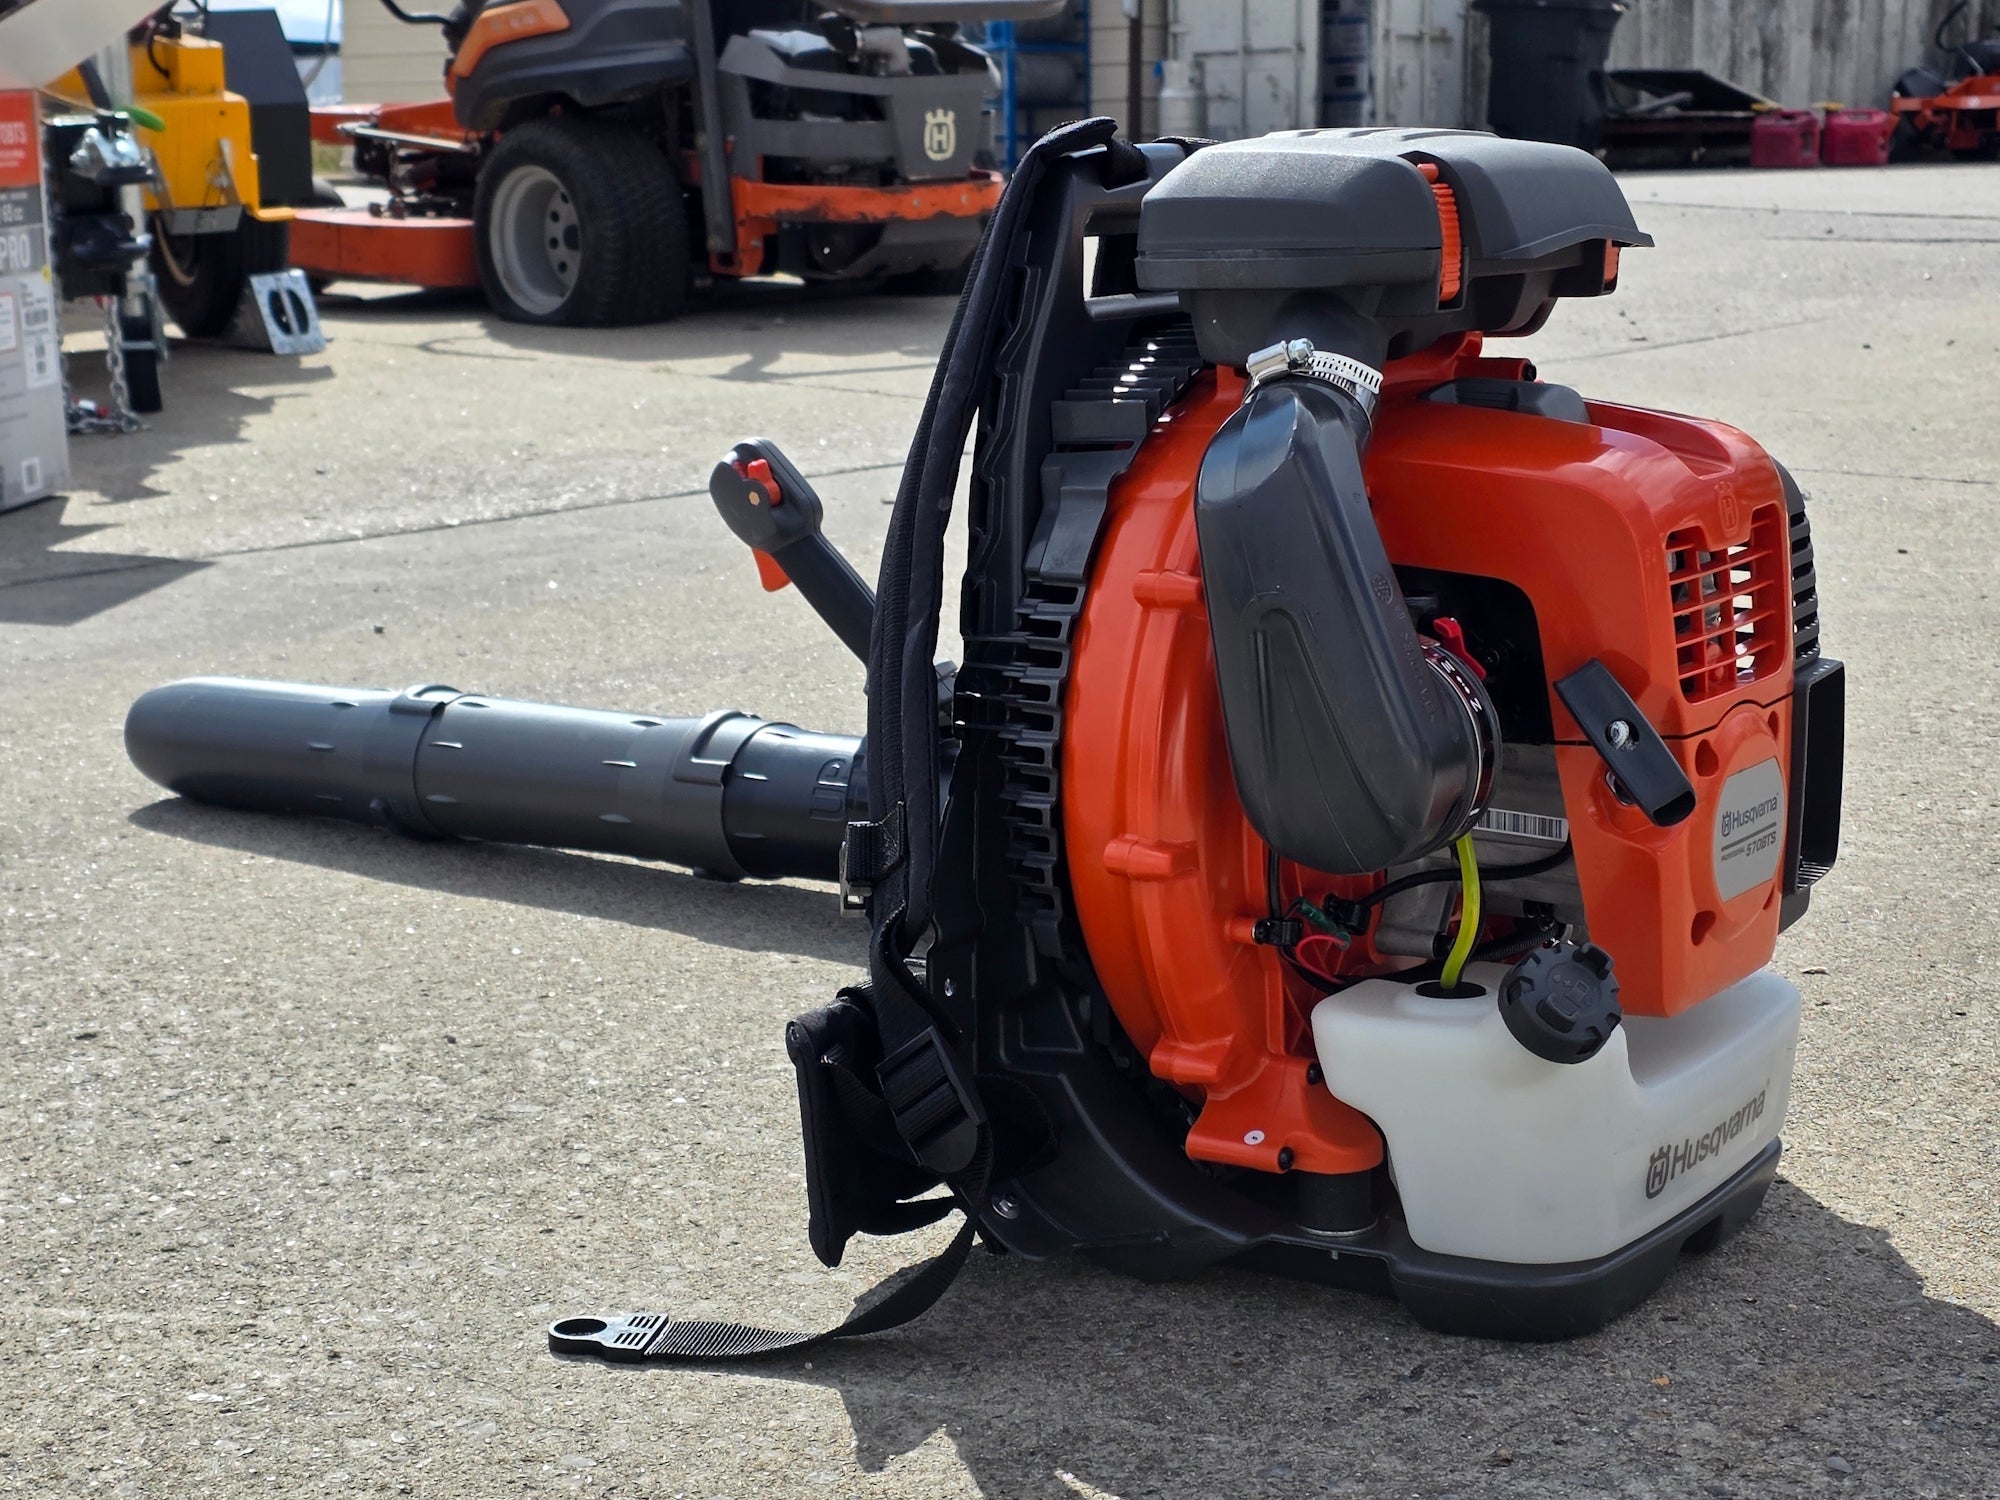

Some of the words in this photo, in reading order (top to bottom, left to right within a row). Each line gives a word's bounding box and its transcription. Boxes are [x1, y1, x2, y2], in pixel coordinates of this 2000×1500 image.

[1732, 796, 1777, 830] Husqvarna
[1745, 831, 1776, 857] 570BTS
[1670, 1090, 1766, 1180] Husqvarna
